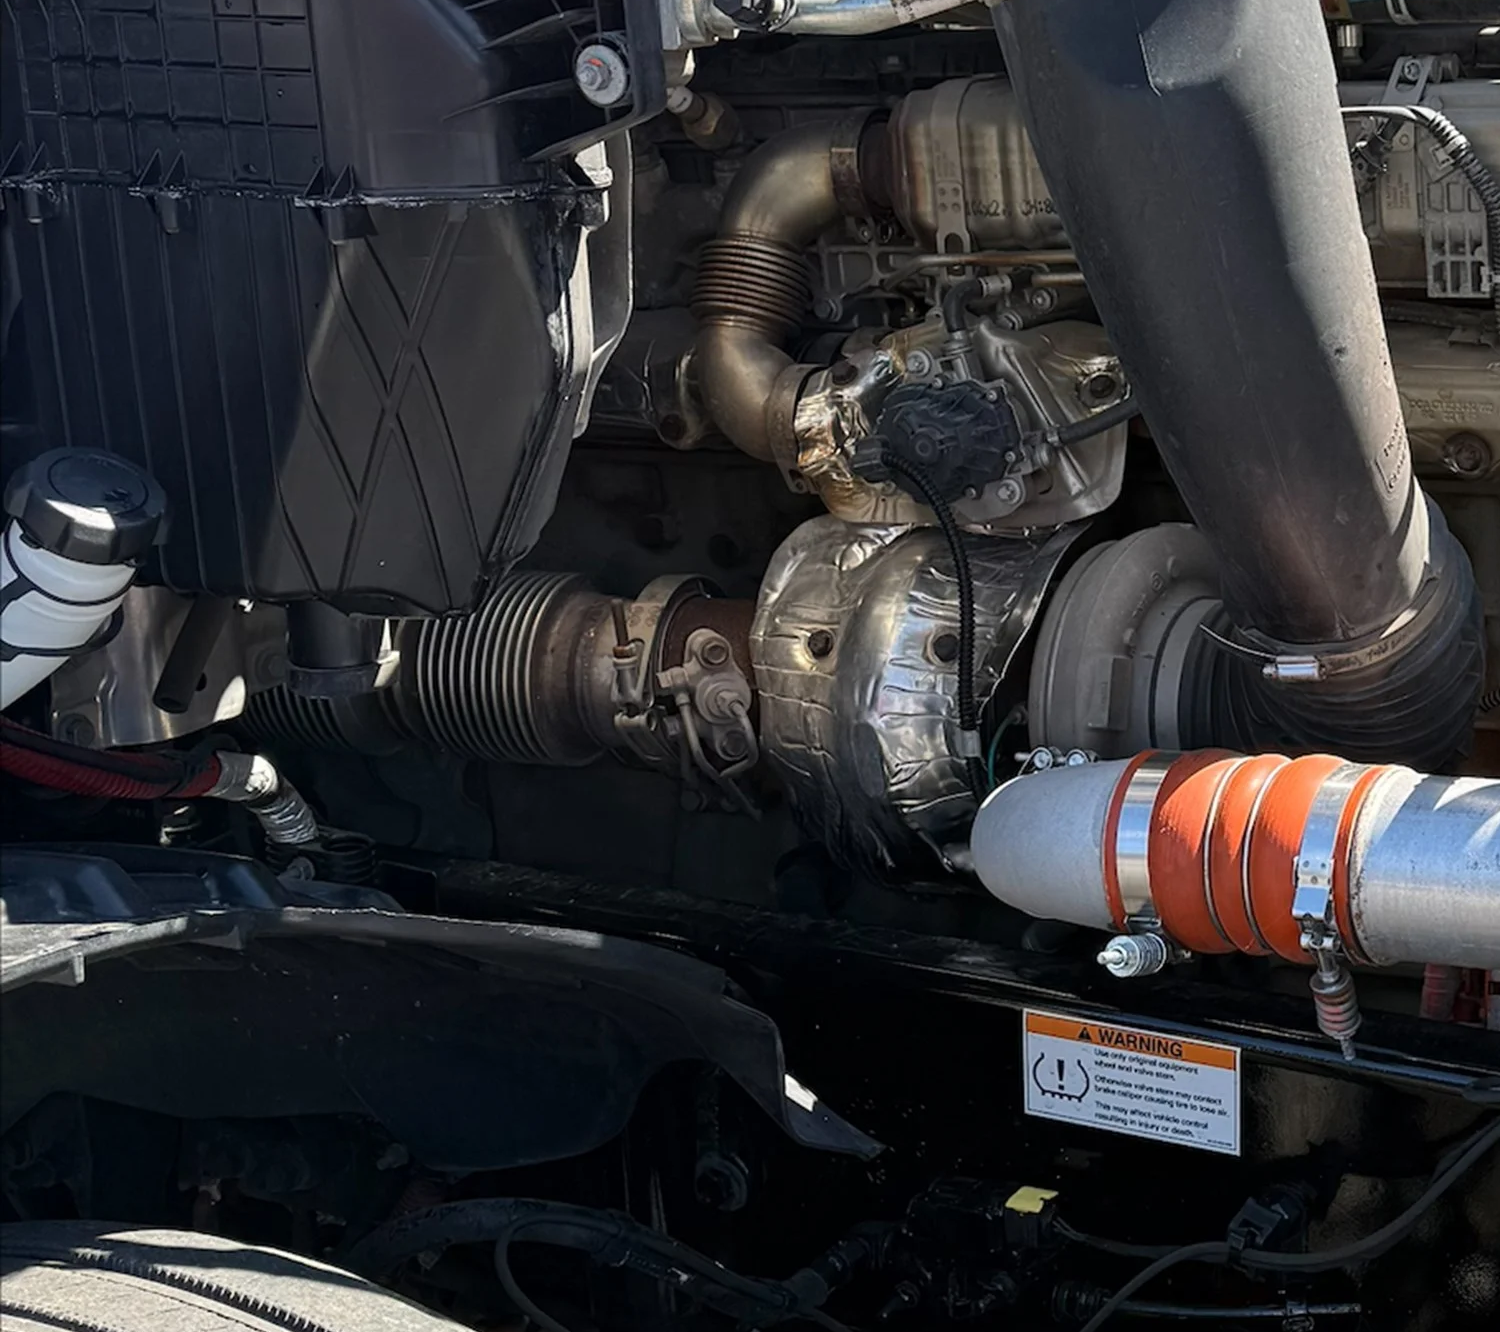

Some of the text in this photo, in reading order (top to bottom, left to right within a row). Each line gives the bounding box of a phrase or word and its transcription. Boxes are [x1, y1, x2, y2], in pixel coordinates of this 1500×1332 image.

[1098, 1028, 1183, 1057] WARNING
[1110, 1051, 1126, 1062] only
[1128, 1054, 1157, 1066] original
[1158, 1063, 1199, 1075] equipment
[1144, 1094, 1174, 1108] causing
[1138, 1120, 1160, 1132] injury
[1181, 1118, 1209, 1130] control
